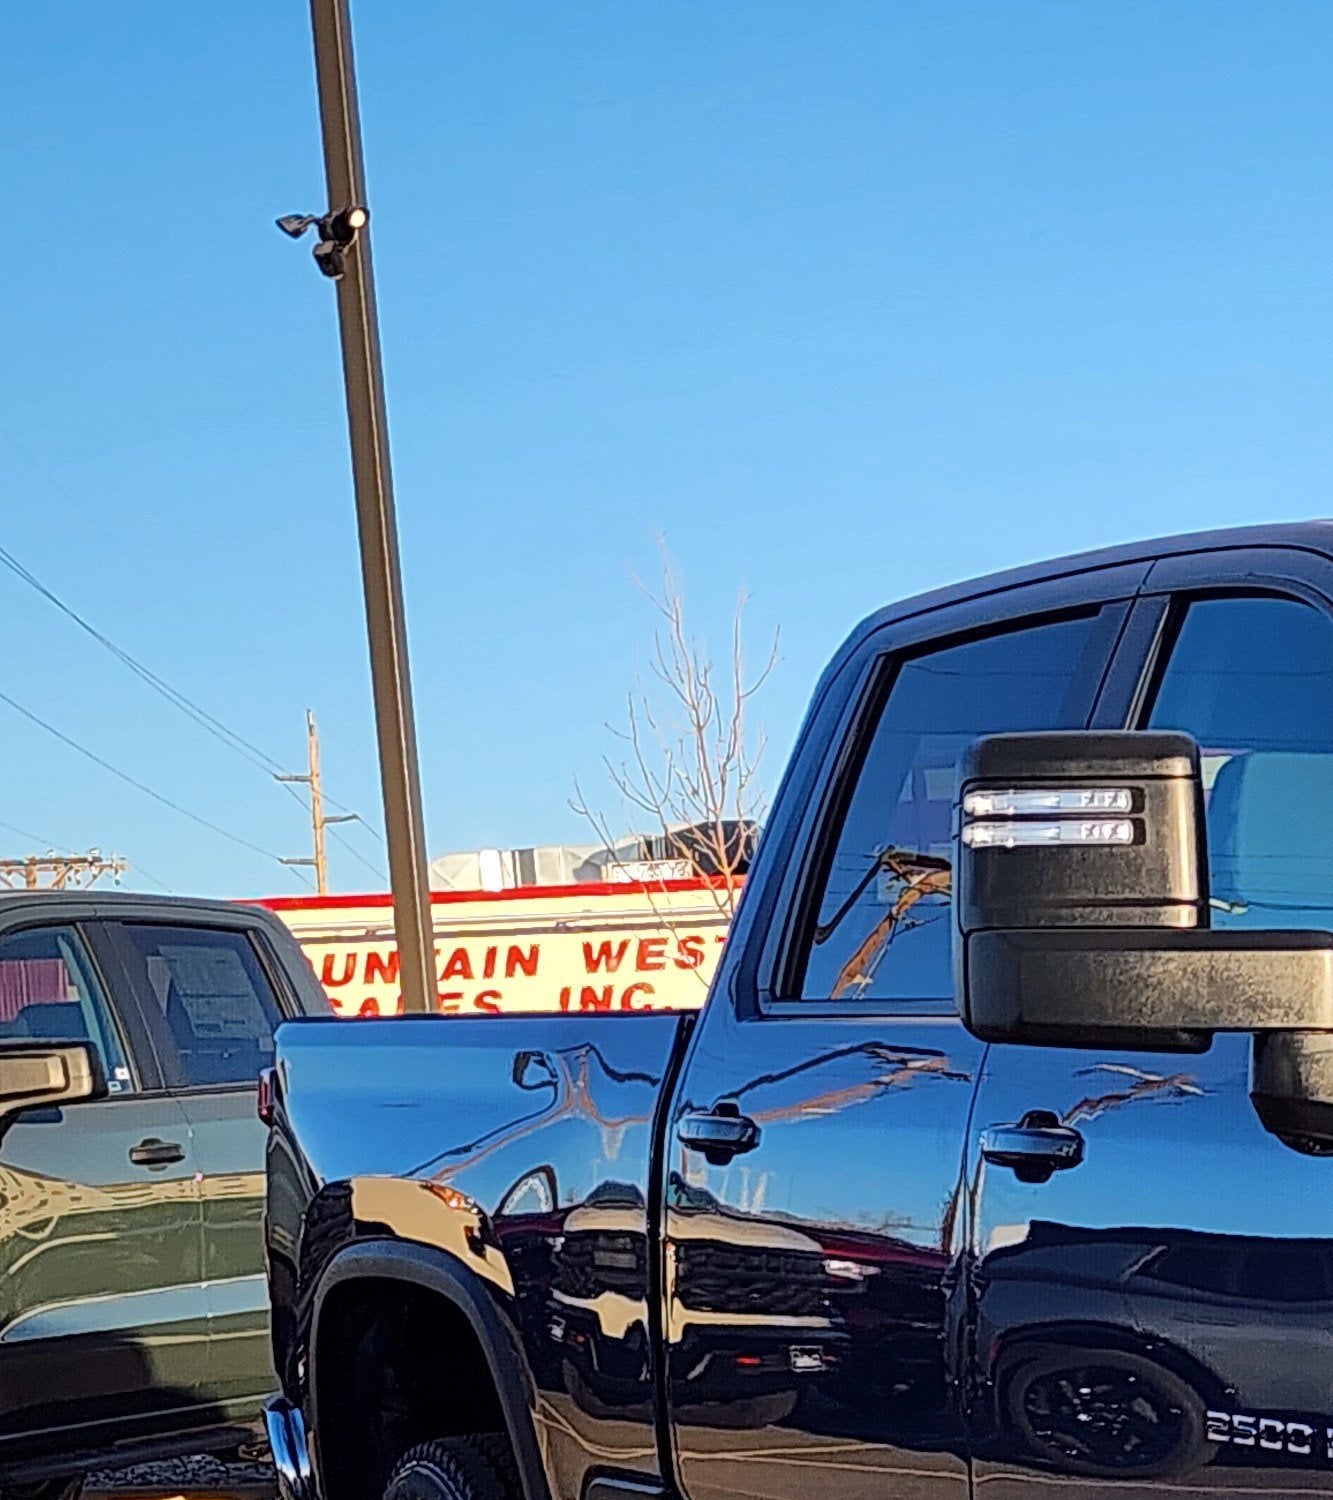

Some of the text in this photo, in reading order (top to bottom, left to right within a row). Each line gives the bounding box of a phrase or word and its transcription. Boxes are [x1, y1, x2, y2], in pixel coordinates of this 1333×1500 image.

[308, 934, 728, 987] UNAIN WES
[1205, 1410, 1315, 1455] 2500
